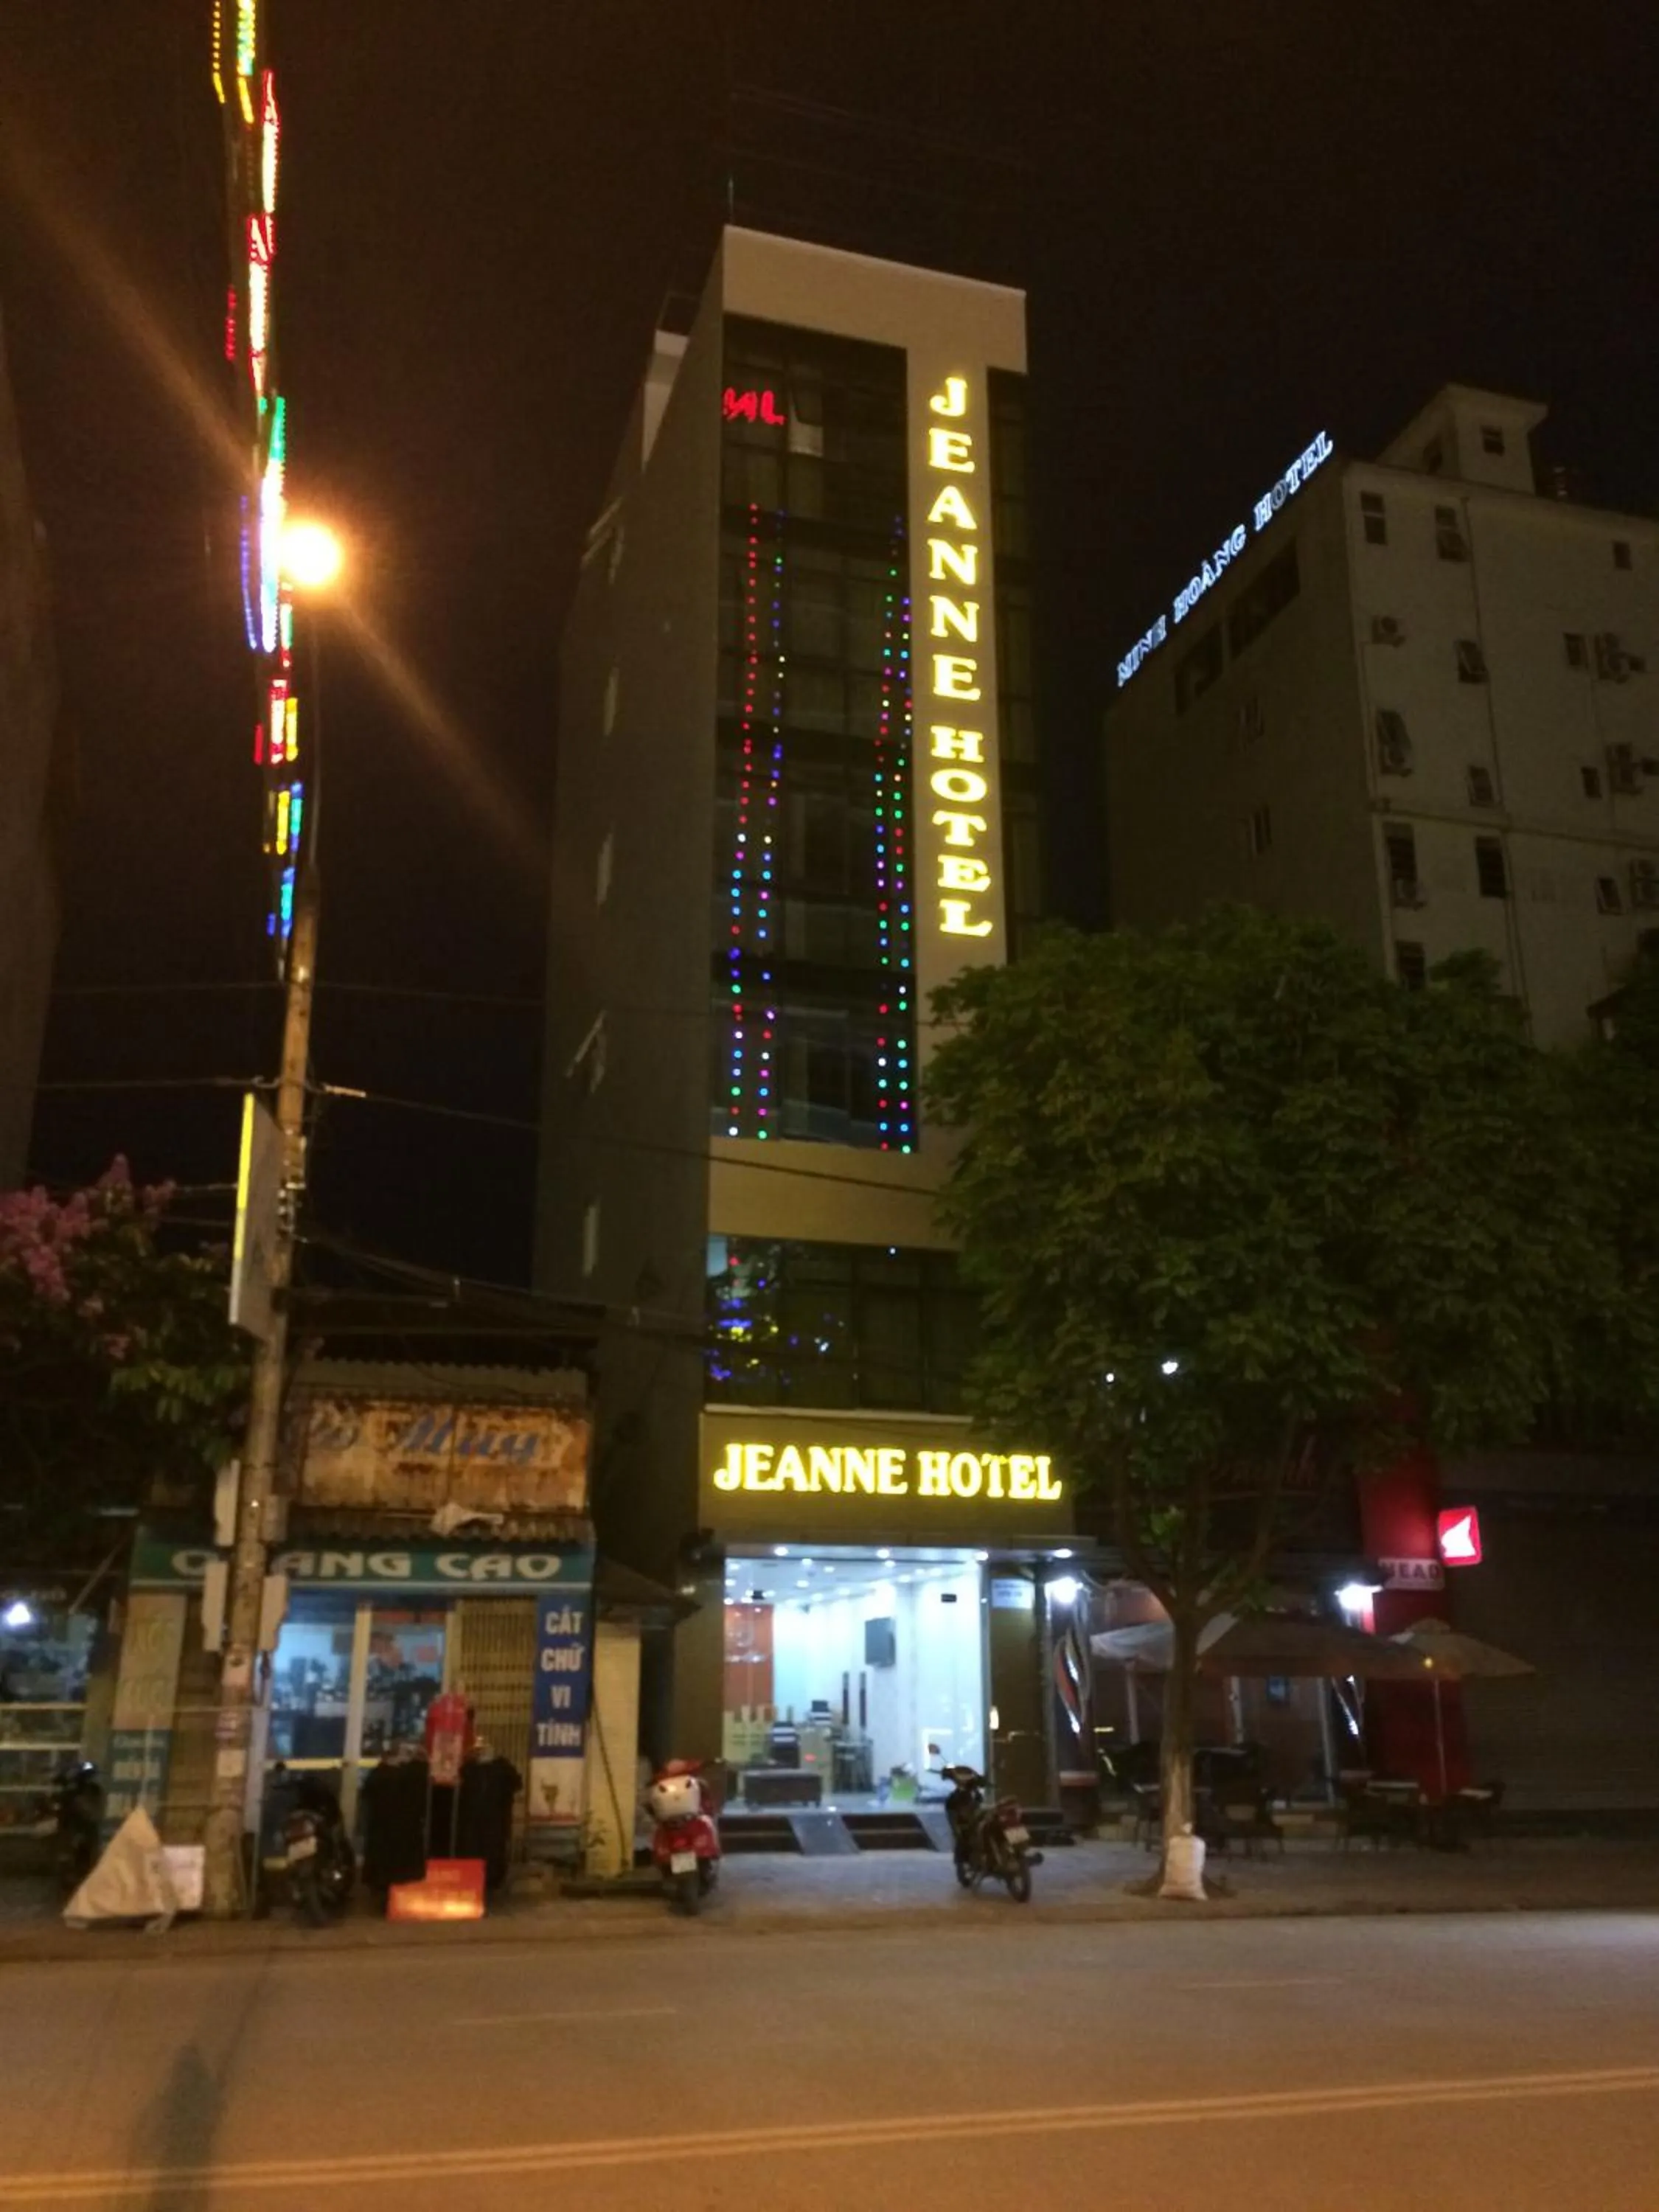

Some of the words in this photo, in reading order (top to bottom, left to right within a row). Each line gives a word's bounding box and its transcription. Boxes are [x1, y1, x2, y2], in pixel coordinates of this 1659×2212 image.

[927, 376, 980, 701] JEANNE
[1253, 430, 1334, 532] HOTEL
[930, 725, 993, 938] HOTEL
[713, 1442, 908, 1495] JEANNE
[917, 1450, 1063, 1500] HOTEL
